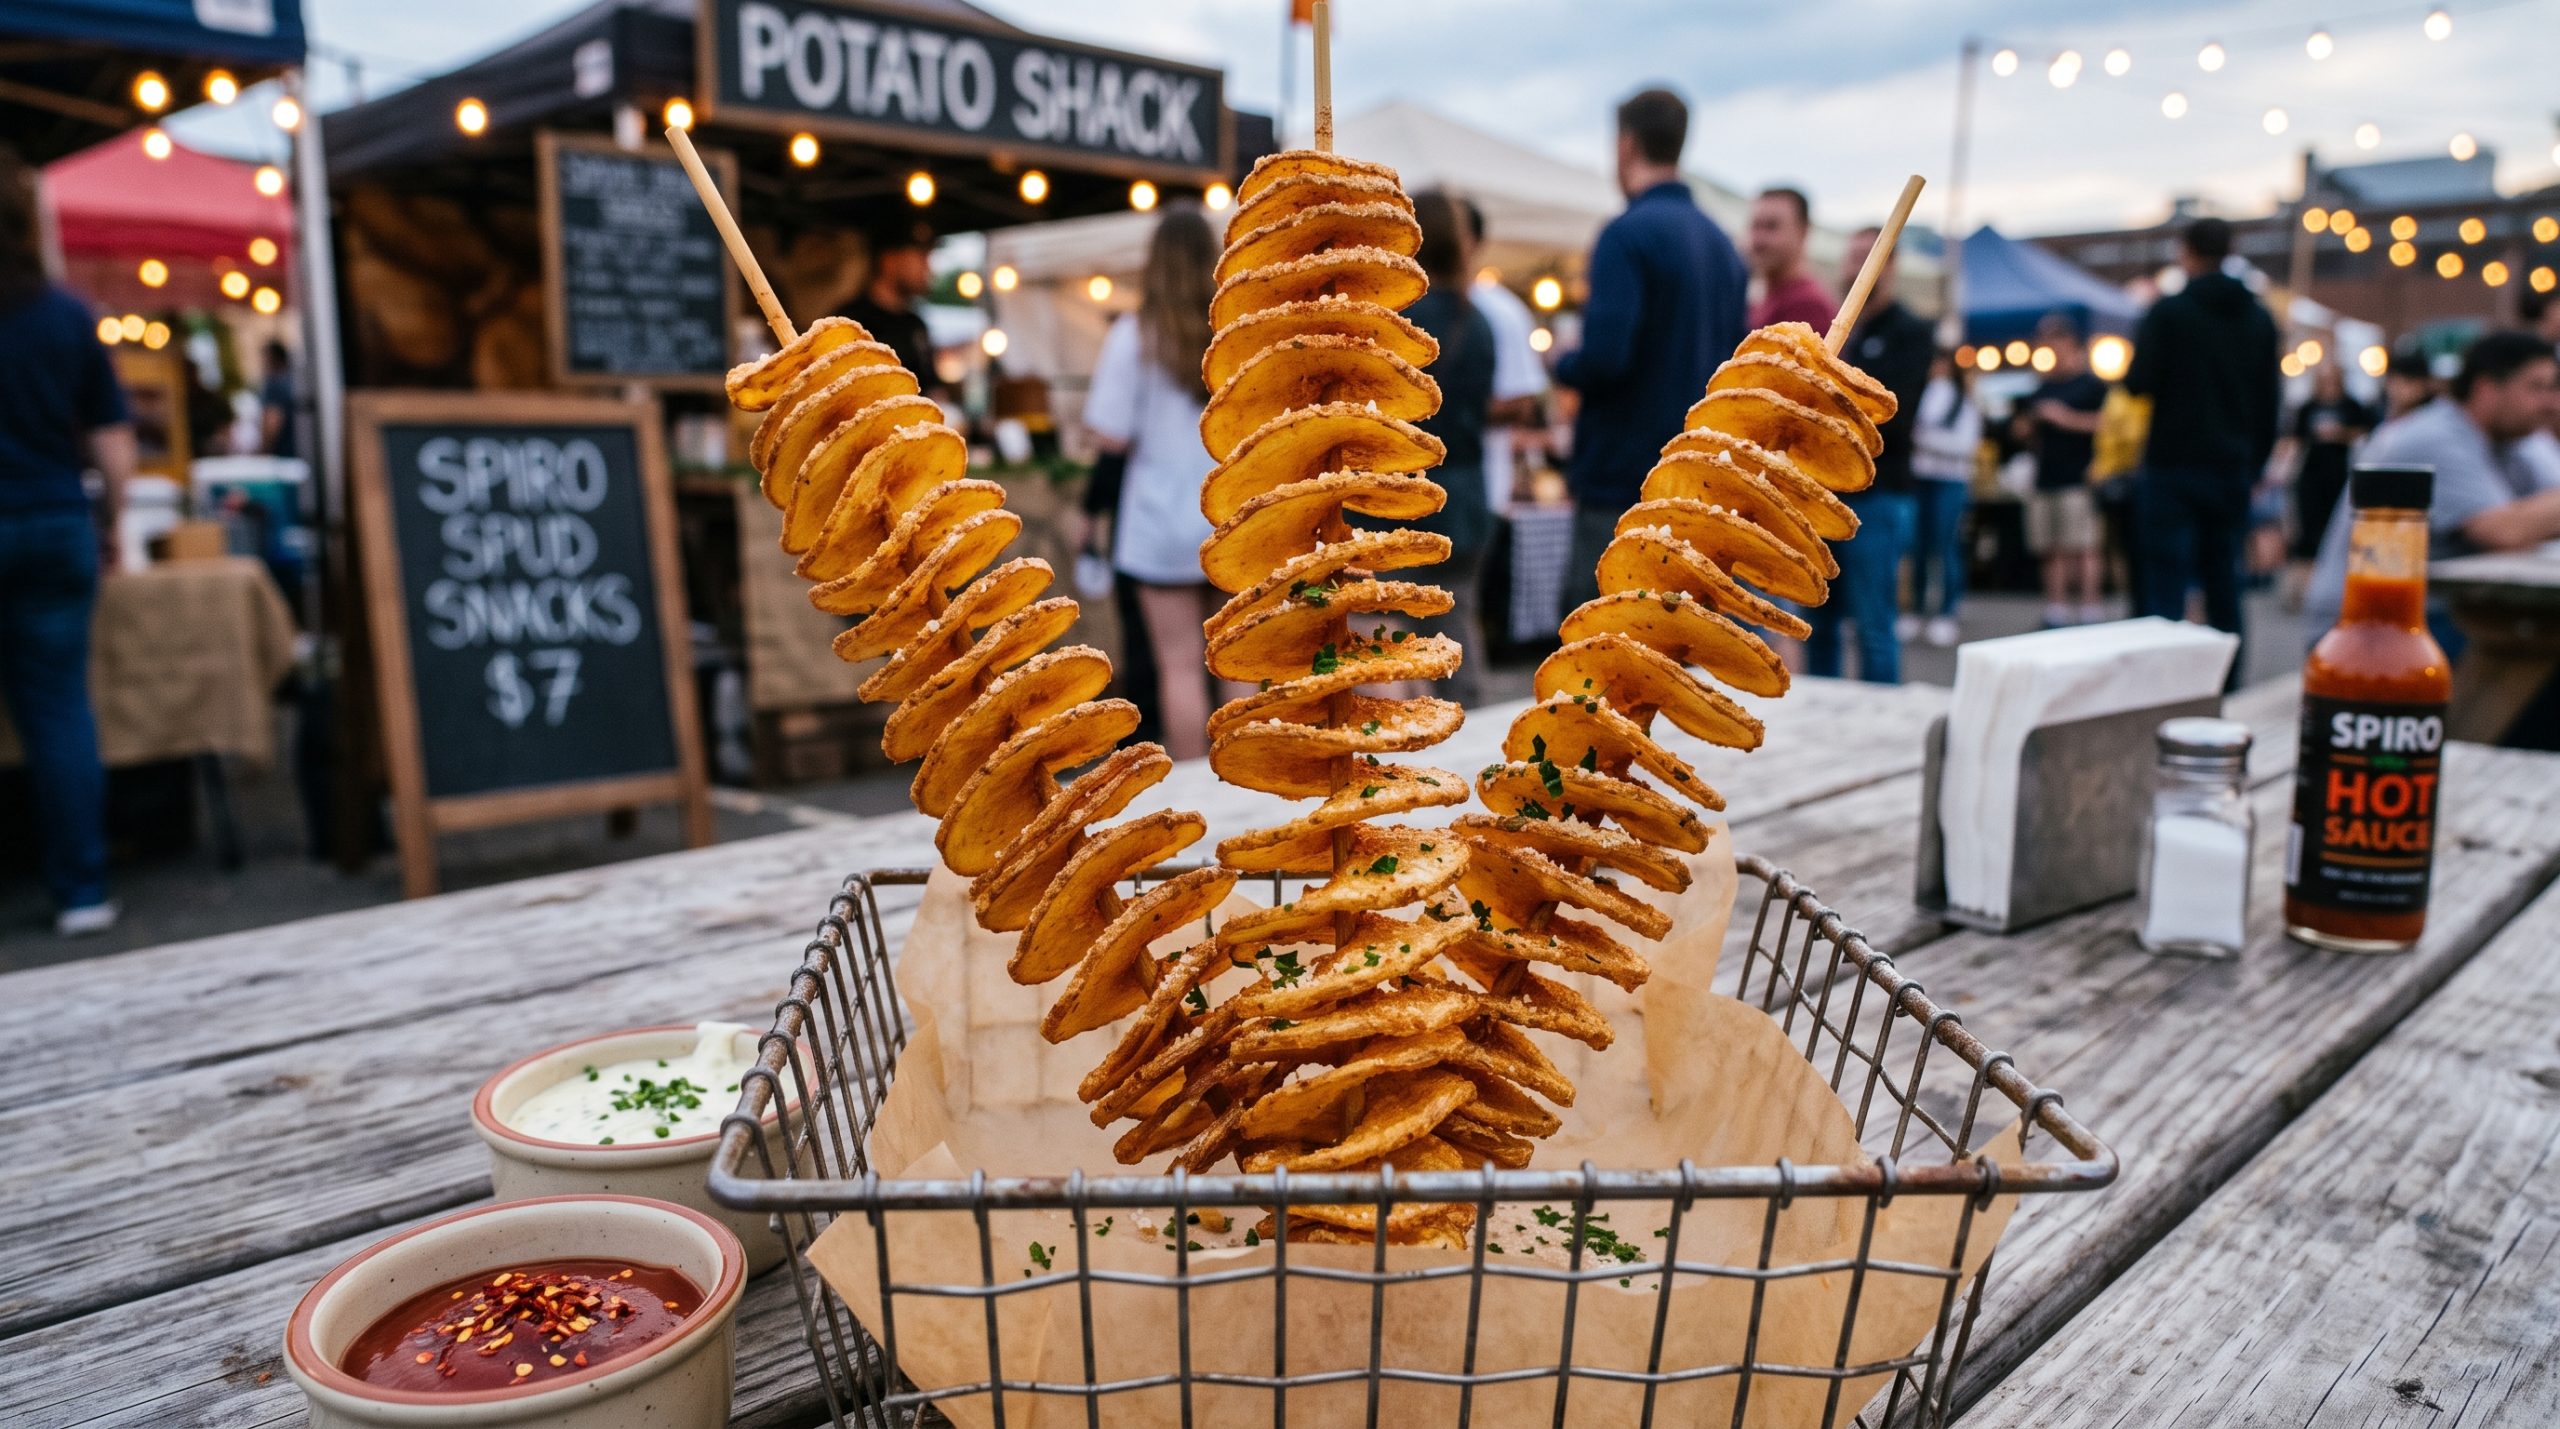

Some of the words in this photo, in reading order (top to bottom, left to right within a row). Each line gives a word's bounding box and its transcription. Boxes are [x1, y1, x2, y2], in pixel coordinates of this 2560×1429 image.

[738, 3, 998, 133] POTATO
[1011, 48, 1205, 164] SHACK
[417, 436, 608, 515] SPIRO
[440, 511, 599, 581] SPUD
[423, 572, 642, 650] SNACKS
[484, 649, 582, 728] $7
[2329, 711, 2444, 752] SPIRO
[2326, 768, 2437, 818] HOT
